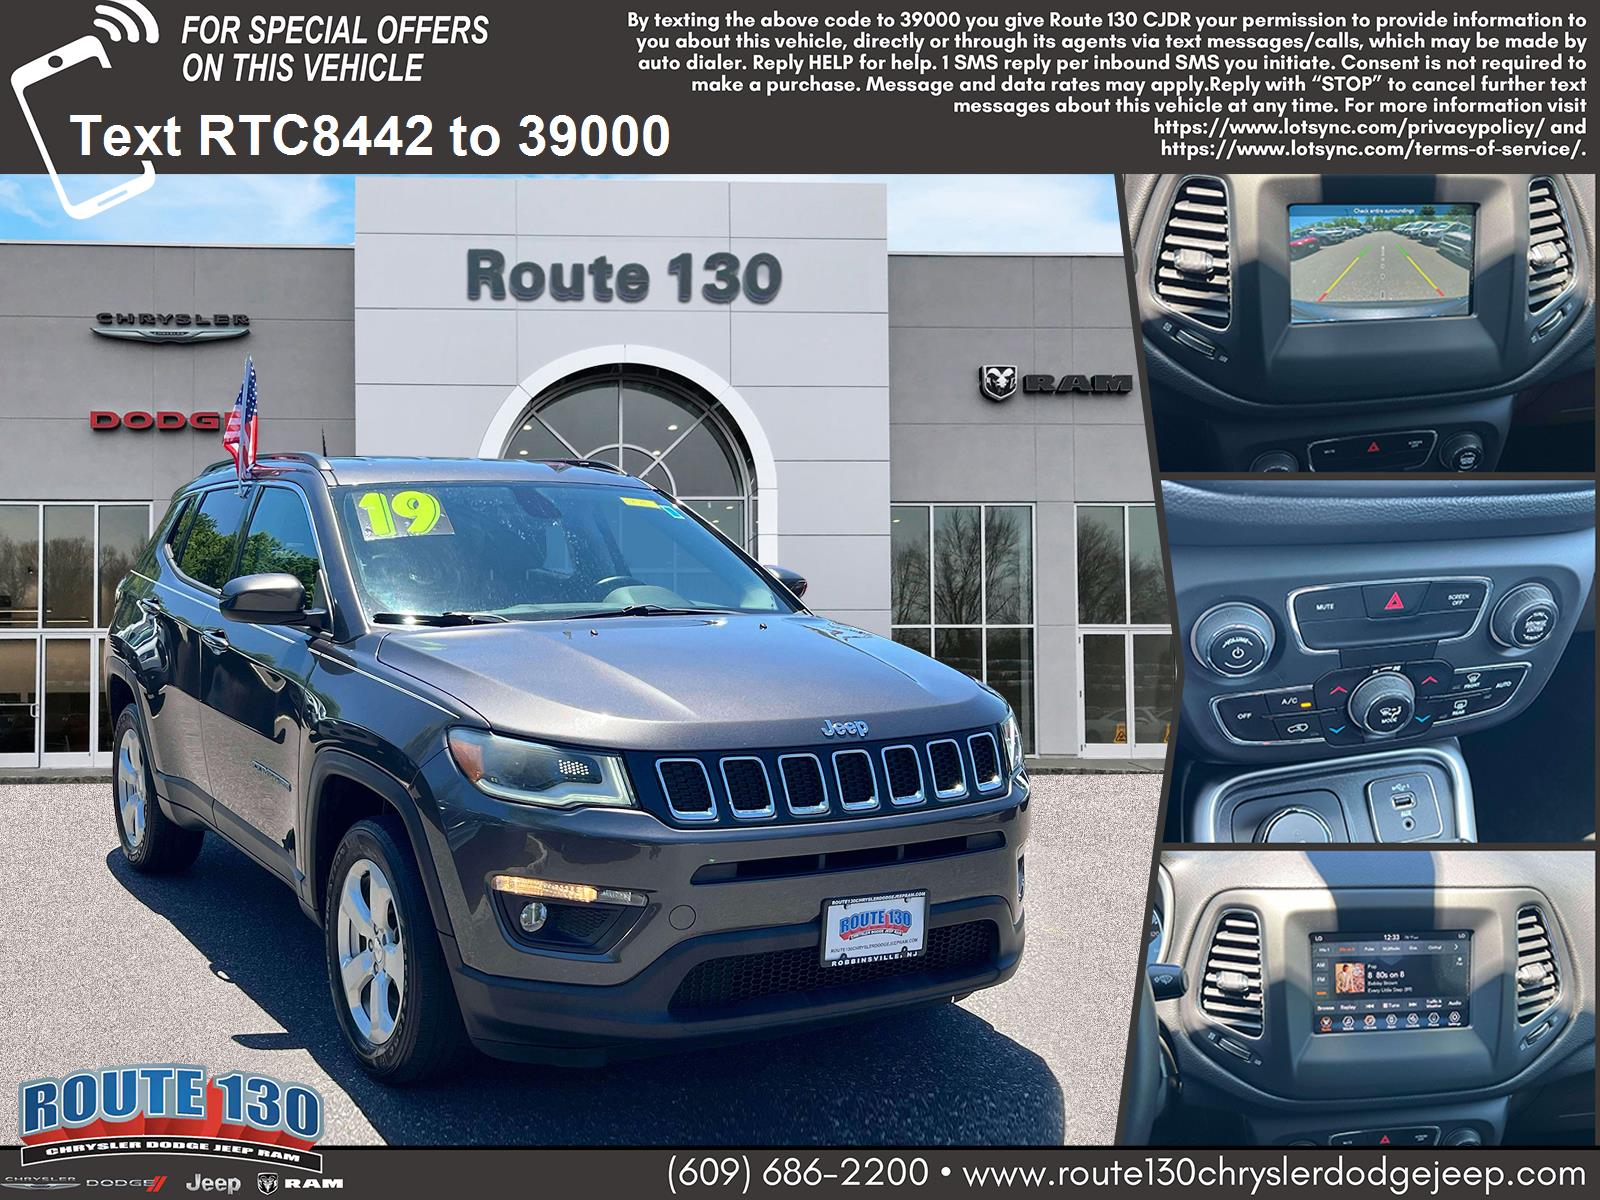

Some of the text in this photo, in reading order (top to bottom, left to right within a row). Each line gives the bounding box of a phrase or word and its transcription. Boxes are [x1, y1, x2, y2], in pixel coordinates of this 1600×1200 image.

[466, 248, 783, 304] Route 130
[96, 312, 250, 326] CHRYSLER
[1023, 374, 1133, 394] RAM
[359, 490, 441, 537] 19
[1316, 603, 1335, 611] MUTE
[1281, 697, 1298, 705] A/C
[821, 719, 869, 737] Jeep
[840, 908, 912, 934] ROUTE 130
